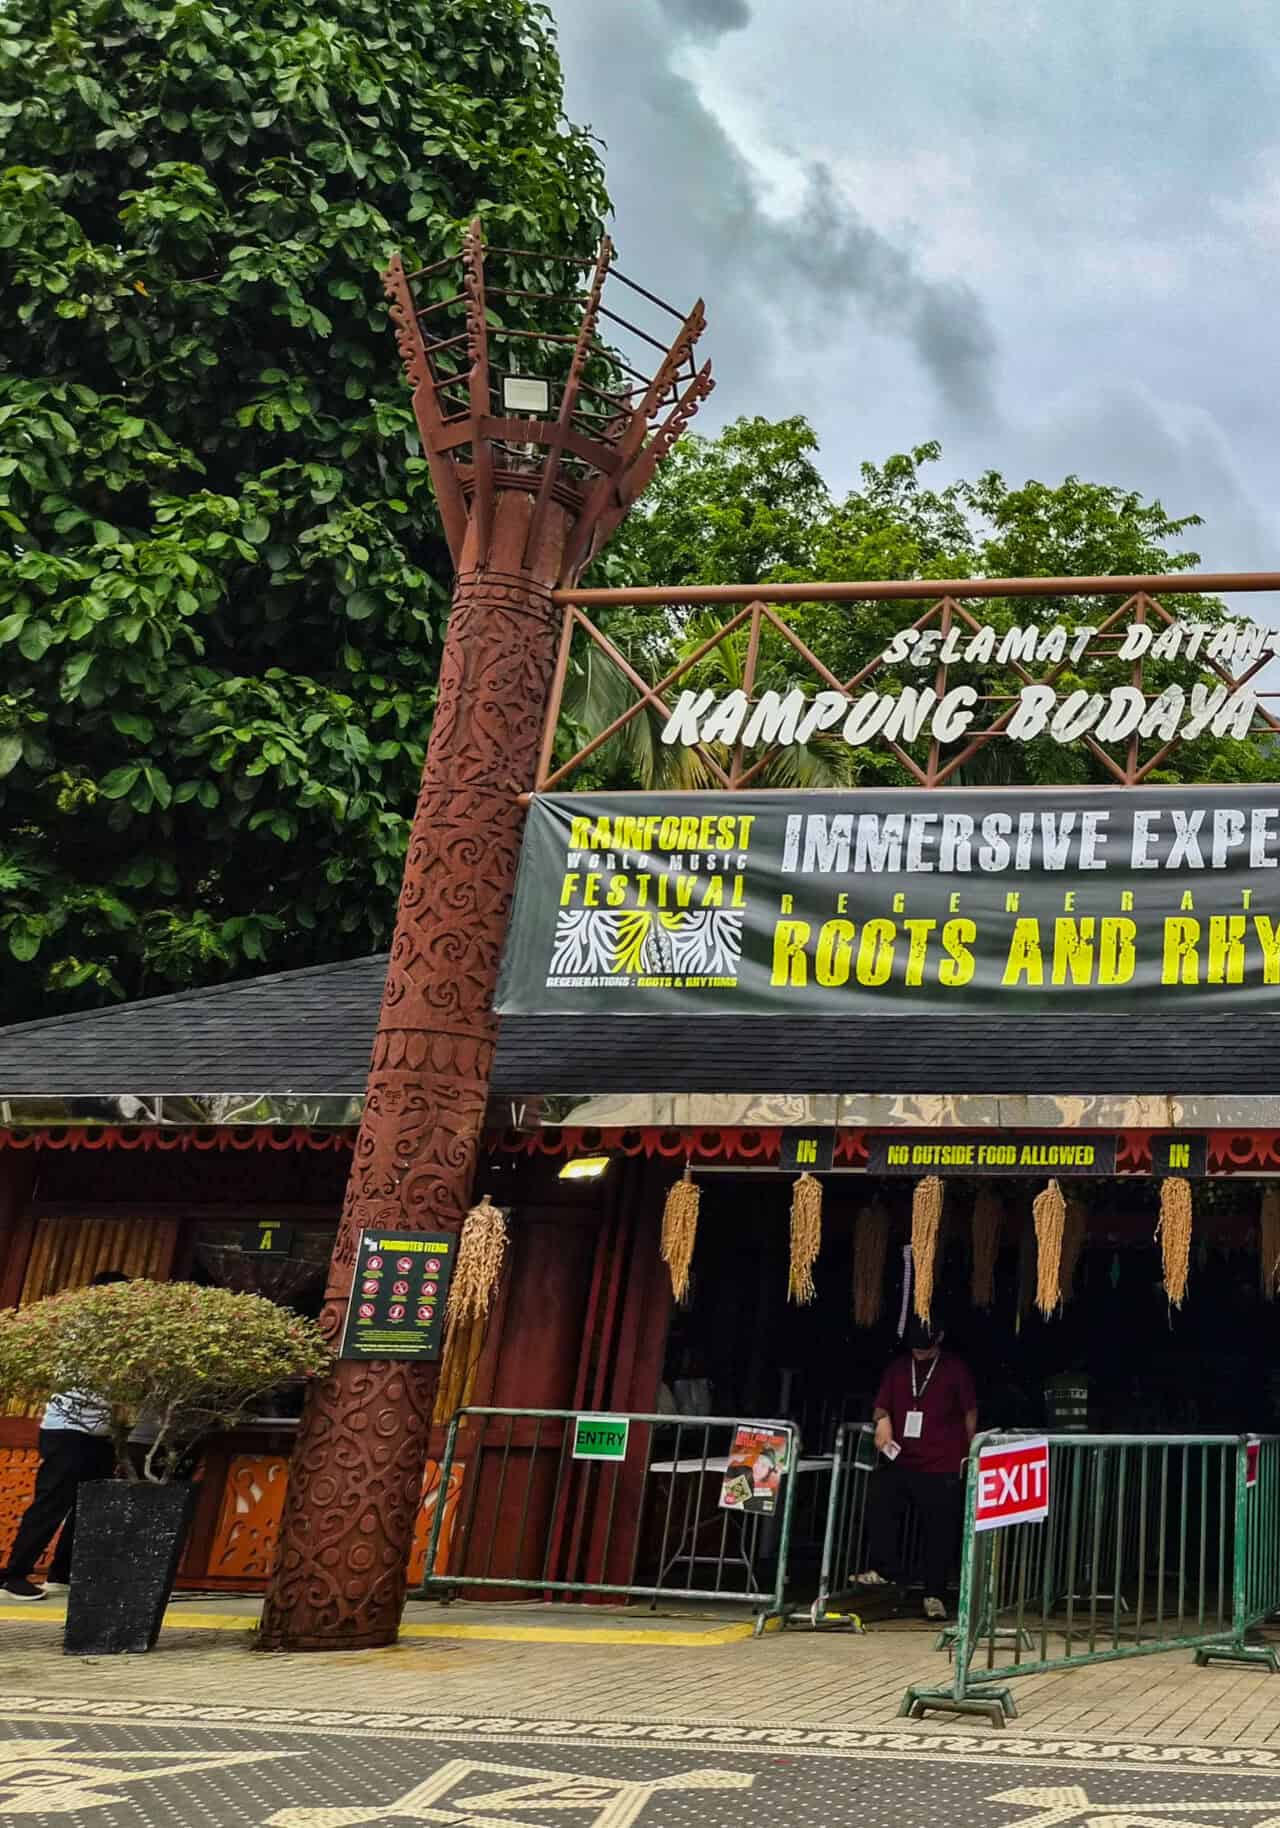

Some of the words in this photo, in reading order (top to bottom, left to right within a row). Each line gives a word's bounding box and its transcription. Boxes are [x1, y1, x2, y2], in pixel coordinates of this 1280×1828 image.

[882, 624, 1099, 666] SELAMAT
[661, 684, 979, 748] KAMPUNG
[1006, 683, 1259, 744] BUDAYA
[568, 815, 756, 850] RAINFOREST
[781, 812, 1111, 873] IMMERSIVE
[567, 852, 649, 870] WORLD
[670, 854, 749, 871] MUSIC
[559, 872, 748, 908] FESTIVAL
[771, 916, 977, 987] ROOTS
[1002, 915, 1136, 985] AND
[797, 1139, 817, 1163] IN
[887, 1145, 908, 1166] NO
[912, 1145, 974, 1165] OUTSIDE
[978, 1145, 1017, 1166] FOOD
[1020, 1144, 1095, 1166] ALLOWED
[1170, 1144, 1190, 1168] IN
[260, 1230, 272, 1250] A
[577, 1431, 625, 1446] ENTRY
[976, 1461, 1047, 1508] EXIT
